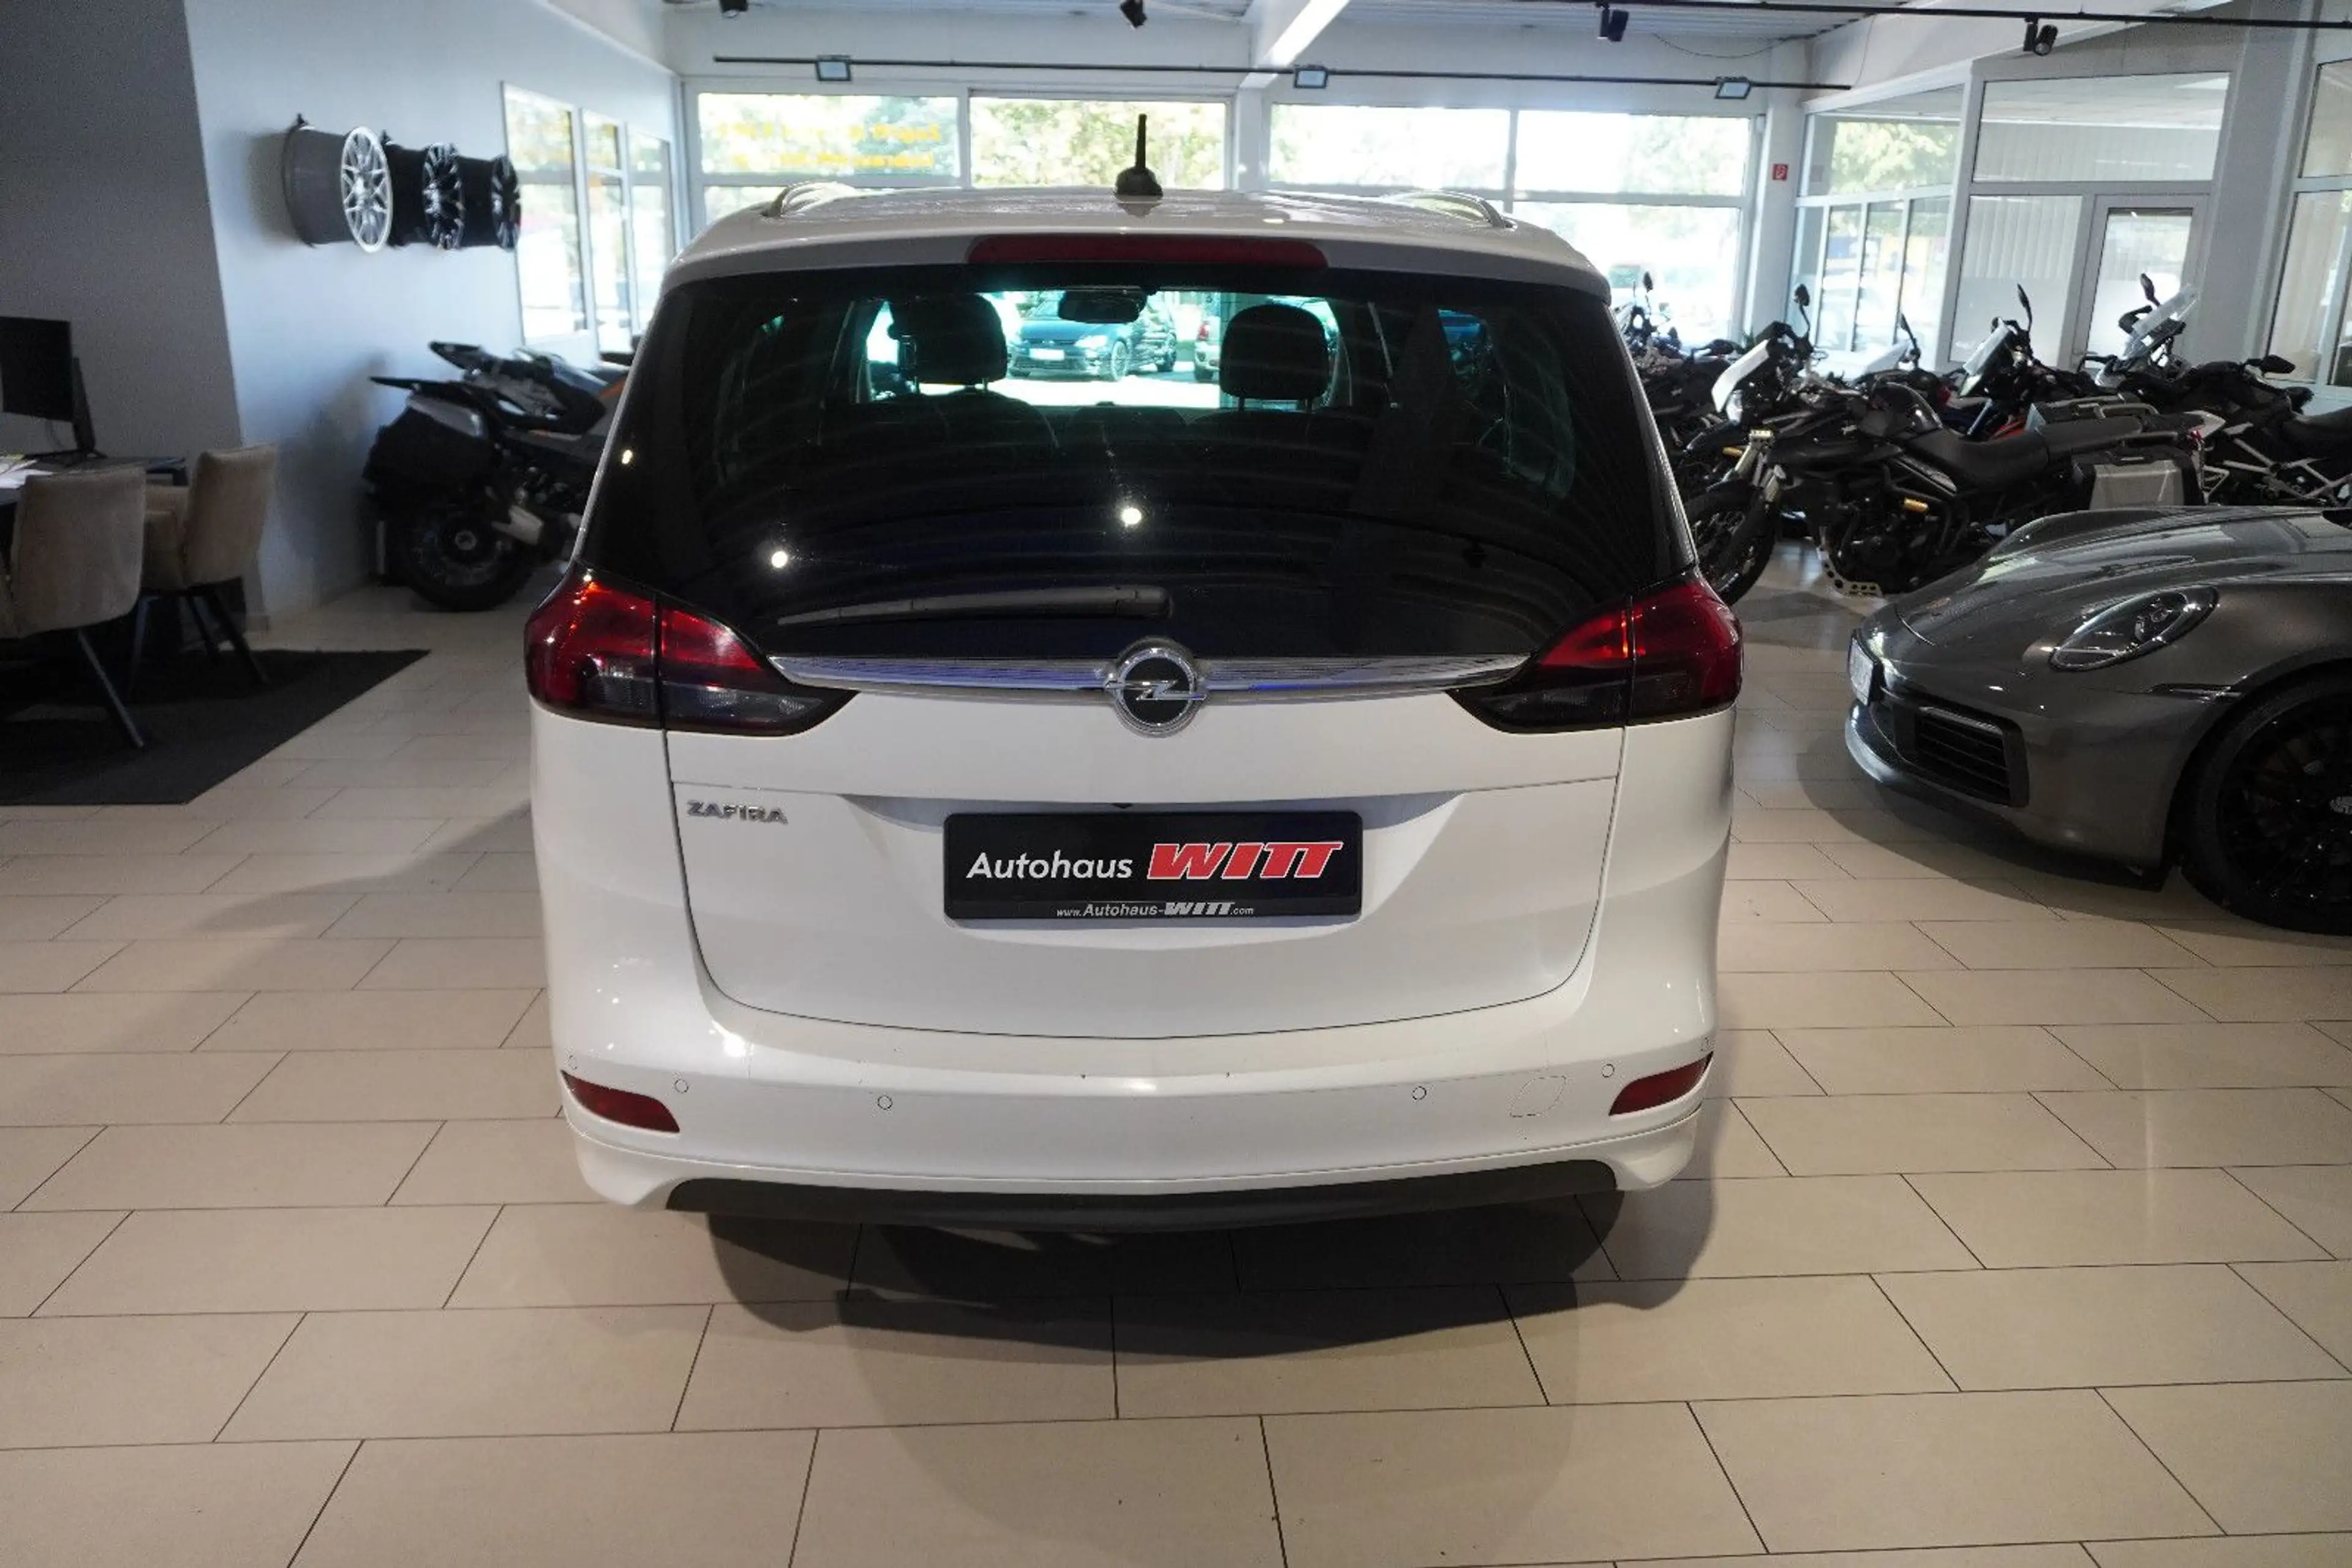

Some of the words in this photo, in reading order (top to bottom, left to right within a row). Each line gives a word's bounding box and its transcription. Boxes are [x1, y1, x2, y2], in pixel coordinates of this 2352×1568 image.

[687, 800, 789, 825] ZAFIRA
[965, 850, 1133, 879] Autohaus
[1147, 842, 1344, 880] WITT
[1056, 902, 1254, 918] www.Autohaus-WITT.com
